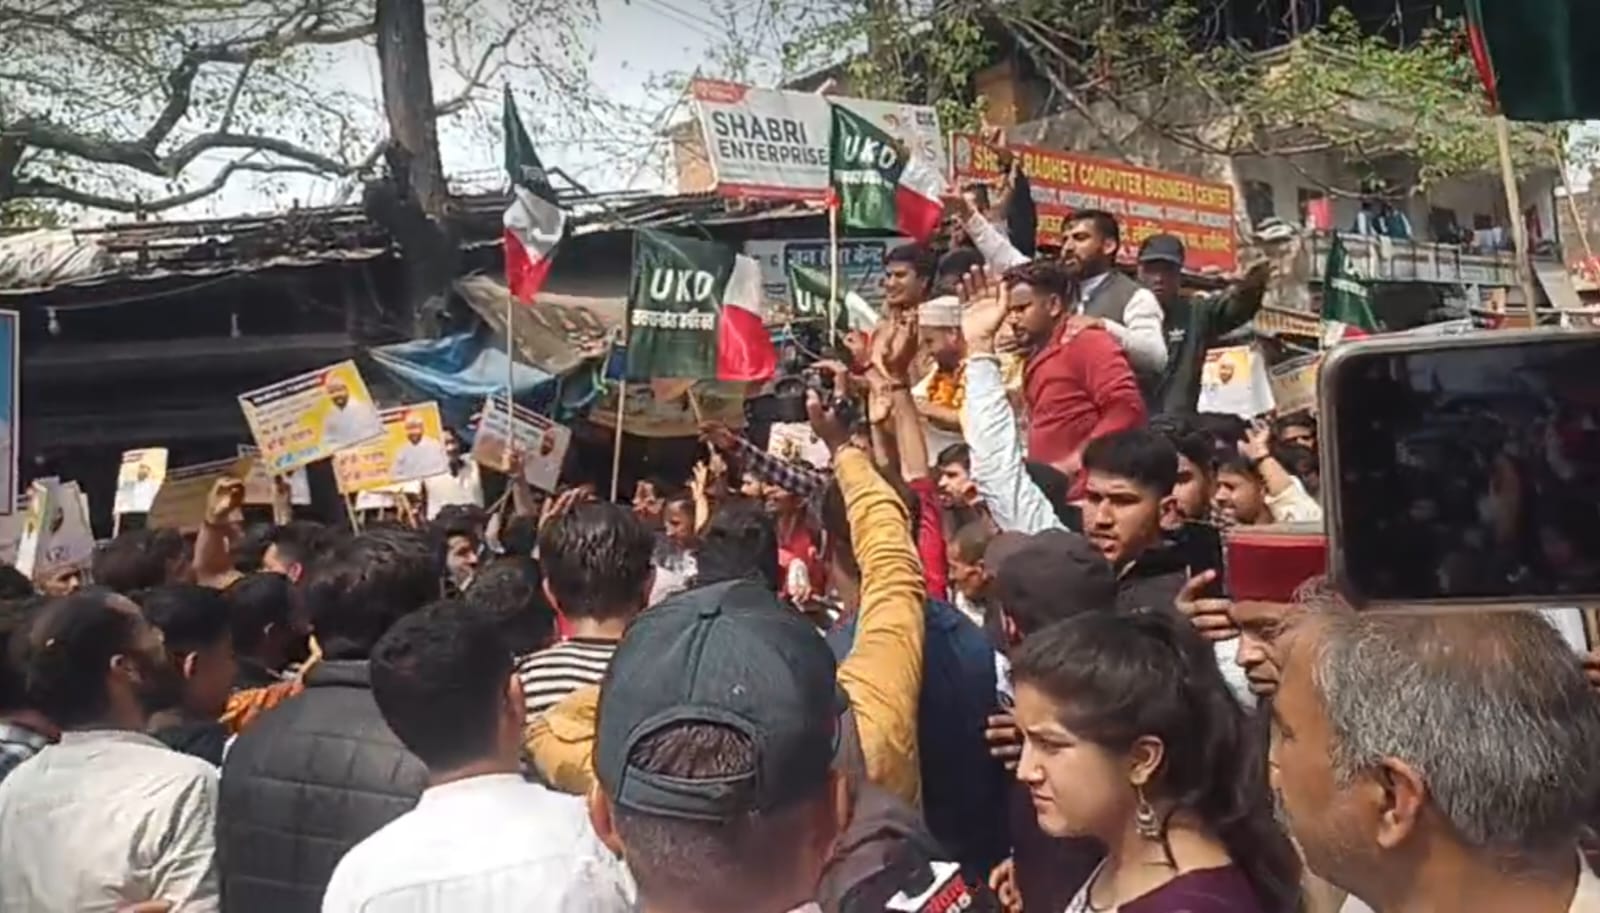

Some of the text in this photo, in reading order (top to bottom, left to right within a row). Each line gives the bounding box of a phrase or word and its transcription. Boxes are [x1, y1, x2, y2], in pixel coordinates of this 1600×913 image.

[711, 110, 808, 145] SHABRI
[718, 141, 829, 167] ENTERPRISE
[843, 134, 898, 170] UKD
[1079, 163, 1143, 196] COMPUTER
[1144, 174, 1194, 205] BUSINESS
[1195, 184, 1232, 210] CENTER
[650, 267, 715, 303] UKD
